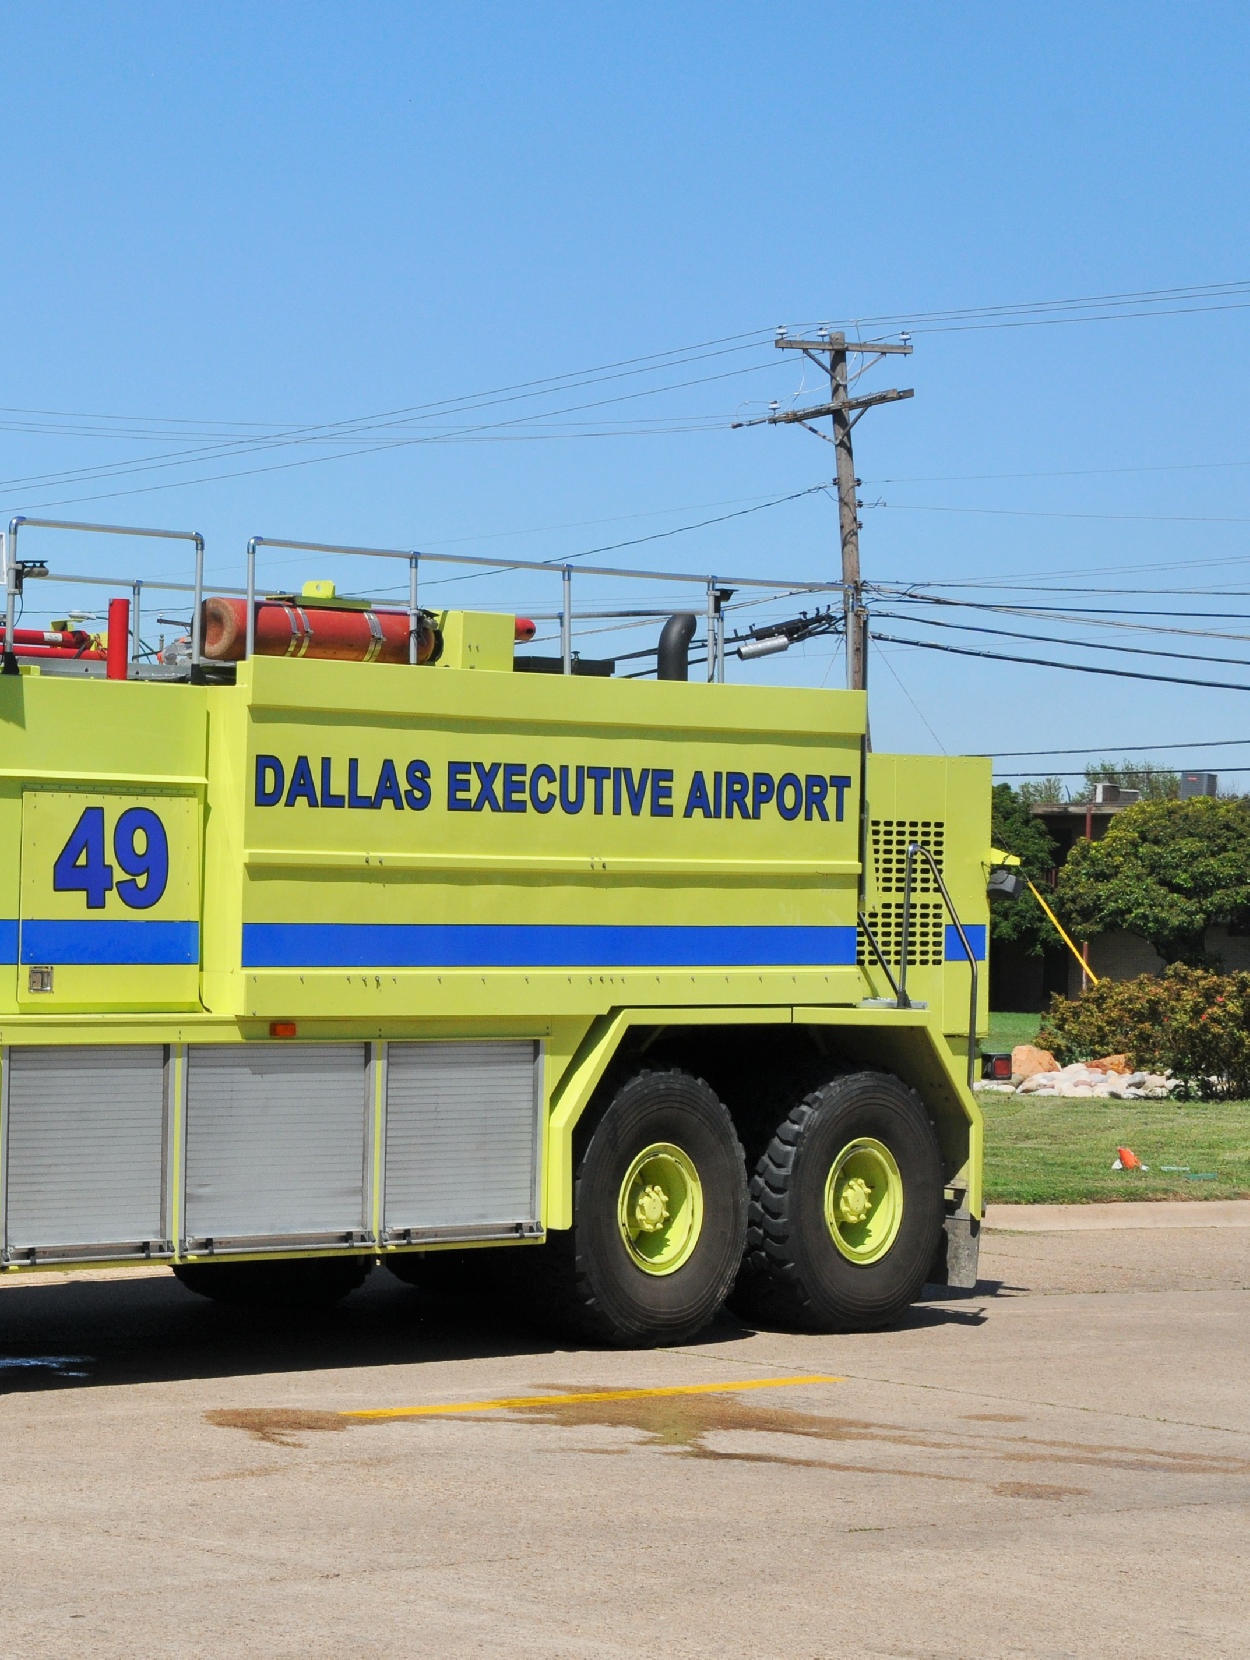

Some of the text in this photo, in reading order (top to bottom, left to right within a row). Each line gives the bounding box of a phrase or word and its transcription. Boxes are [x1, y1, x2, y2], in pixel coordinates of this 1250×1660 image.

[254, 754, 852, 822] DALLAS EXECUTIVE AIRPORT
[52, 806, 169, 910] 49
